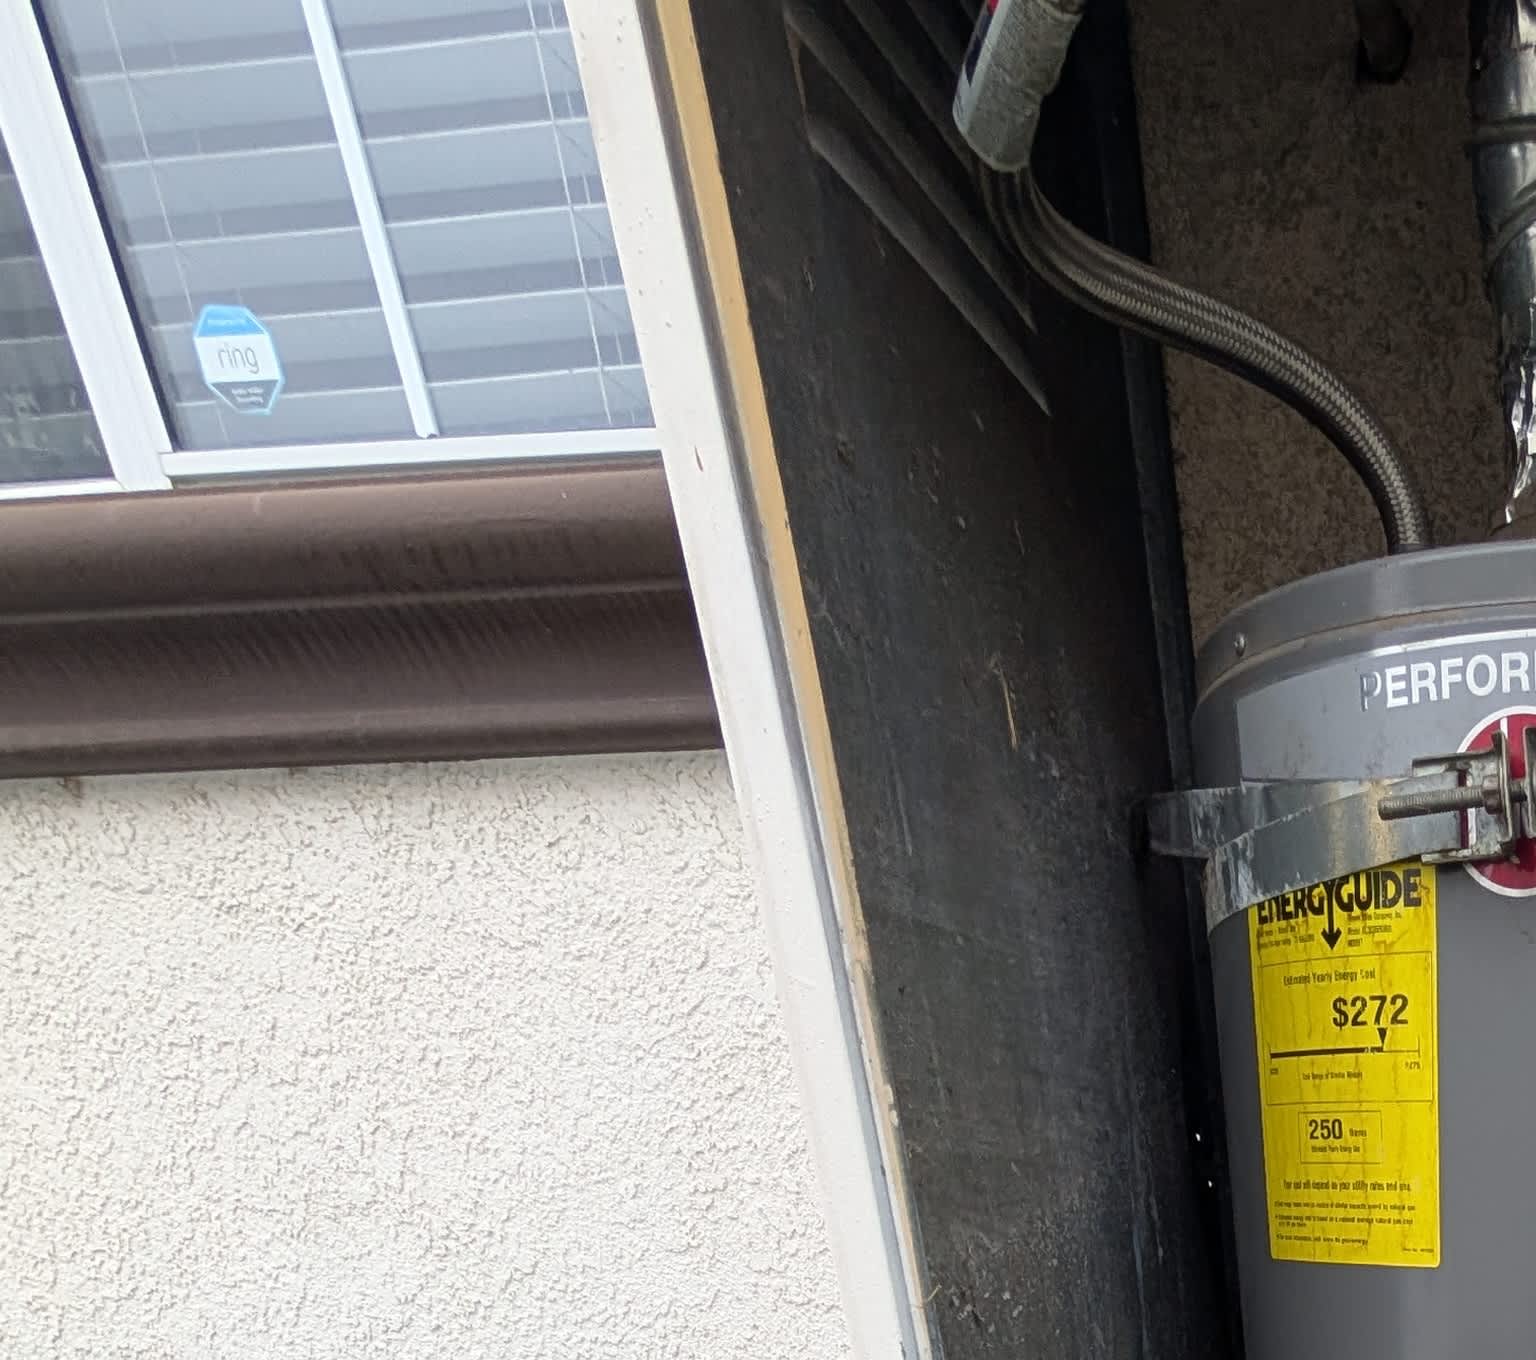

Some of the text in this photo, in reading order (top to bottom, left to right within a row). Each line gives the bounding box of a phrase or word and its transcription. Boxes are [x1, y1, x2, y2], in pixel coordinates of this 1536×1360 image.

[218, 342, 259, 374] ring
[1334, 969, 1357, 982] Energy
[1332, 994, 1408, 1030] $272
[1309, 1119, 1343, 1140] 250
